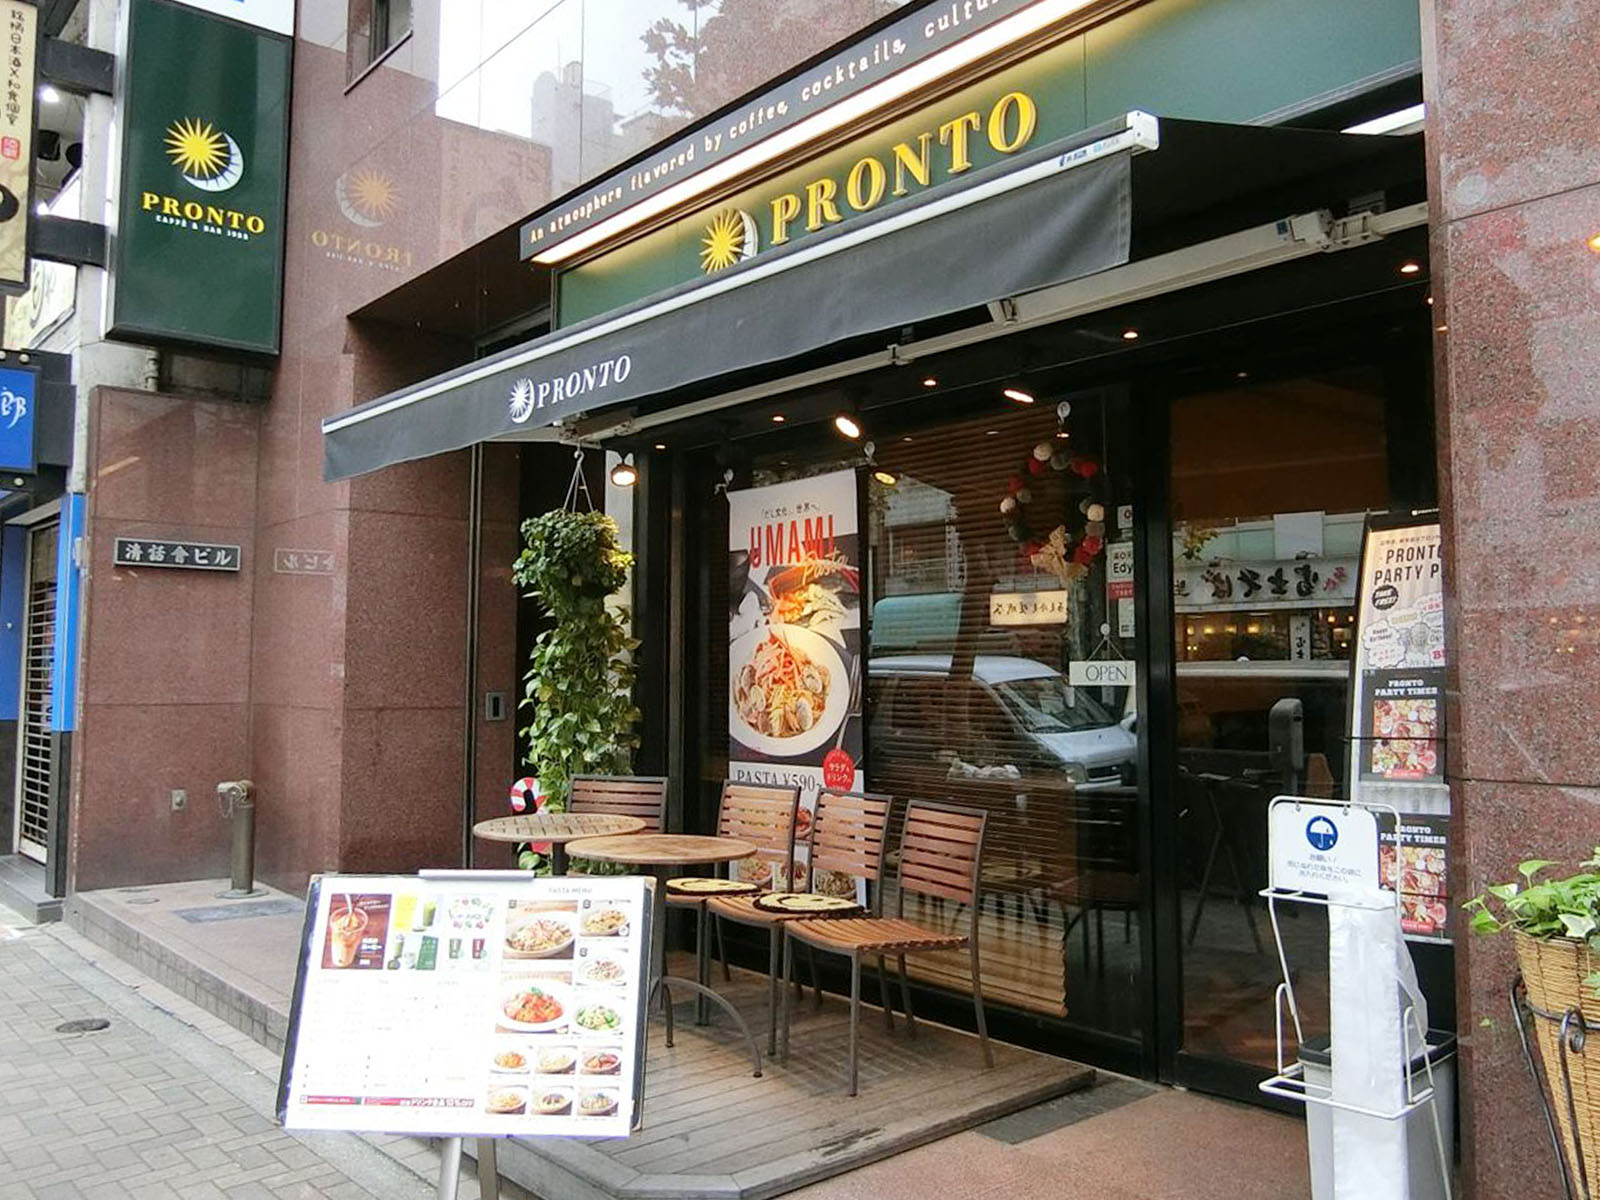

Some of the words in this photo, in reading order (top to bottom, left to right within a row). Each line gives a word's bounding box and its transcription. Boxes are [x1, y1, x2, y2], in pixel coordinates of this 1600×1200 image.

[769, 91, 1037, 246] PRONTO
[530, 228, 544, 244] An
[550, 186, 622, 233] atmosphere
[630, 145, 695, 192] flavored
[704, 132, 722, 152] by
[141, 191, 265, 234] PRONTO
[203, 225, 222, 235] BAR
[536, 354, 631, 409] PRONTO
[750, 514, 835, 569] UMAMI
[1113, 562, 1134, 575] Edy
[1374, 565, 1423, 586] PARTY
[1085, 664, 1127, 682] OPEN
[1374, 688, 1405, 696] PARTY
[1388, 679, 1424, 687] PRONTO
[737, 770, 778, 785] PASTA
